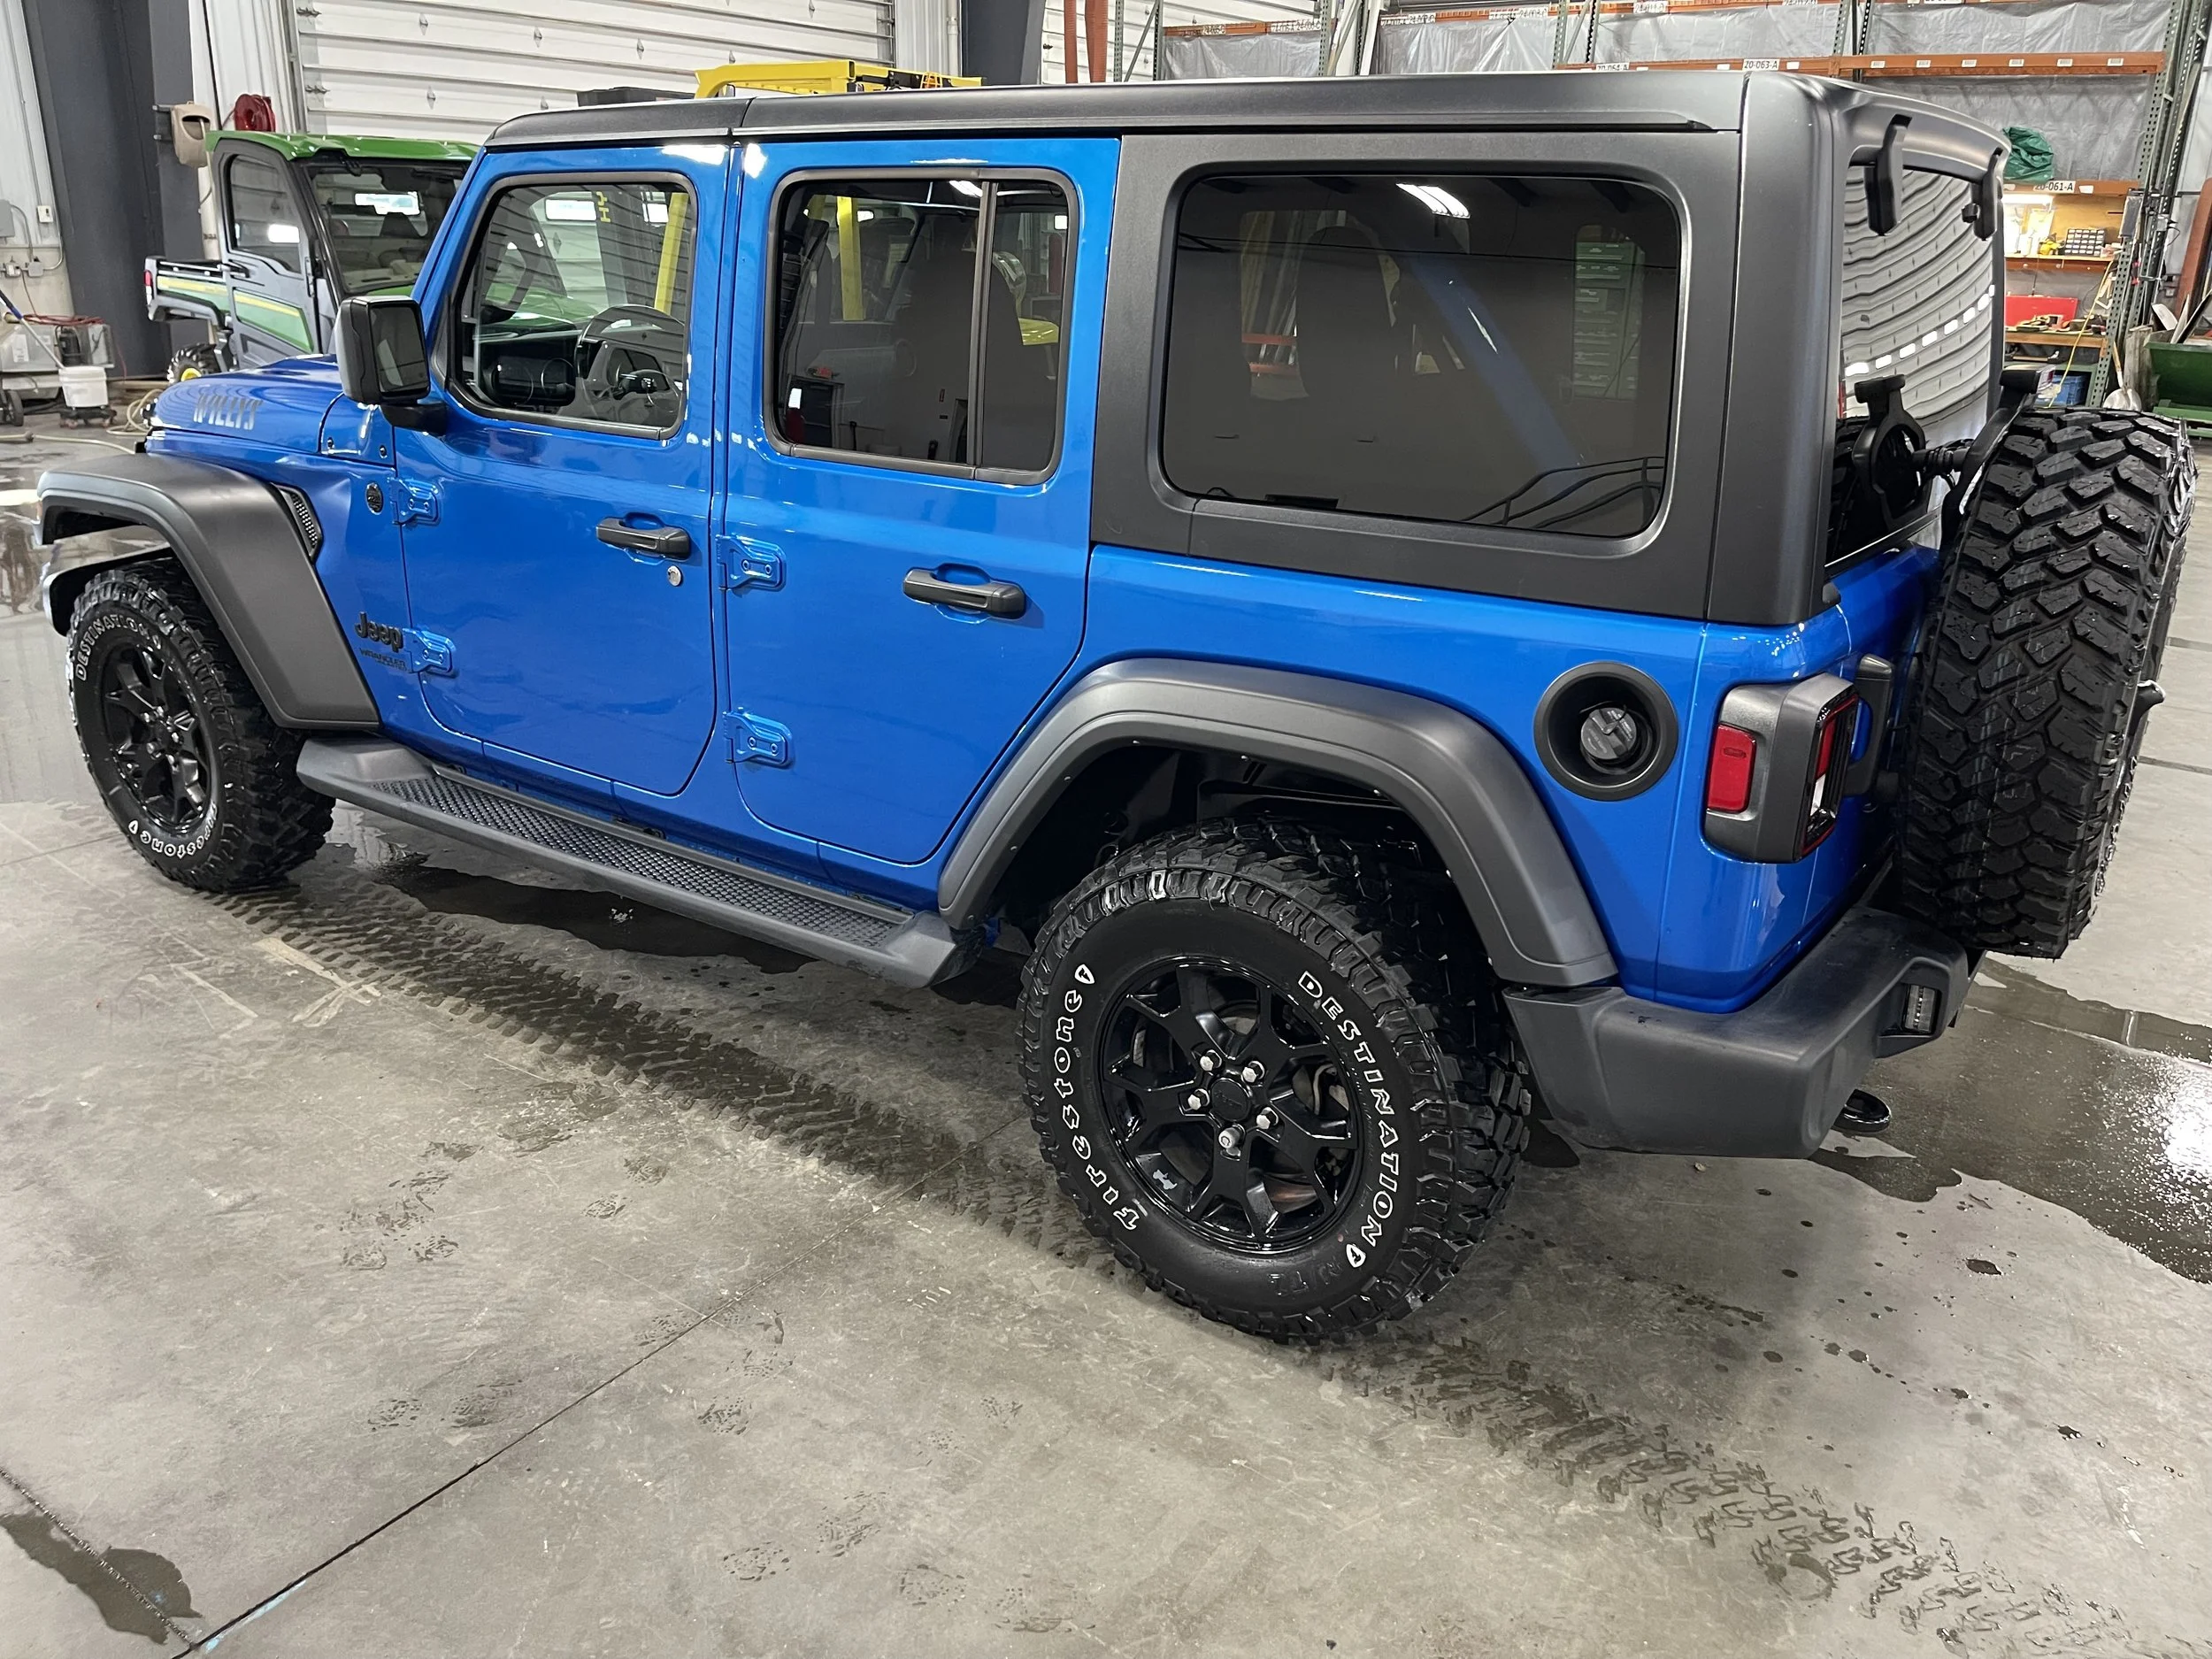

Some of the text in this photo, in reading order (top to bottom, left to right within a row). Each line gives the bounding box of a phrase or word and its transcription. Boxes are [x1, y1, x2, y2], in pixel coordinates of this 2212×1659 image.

[1744, 60, 1778, 69] 20-063-A
[354, 611, 403, 653] Jeep
[1054, 989, 1140, 1231] Firestone
[1298, 971, 1400, 1248] DESTINATION
